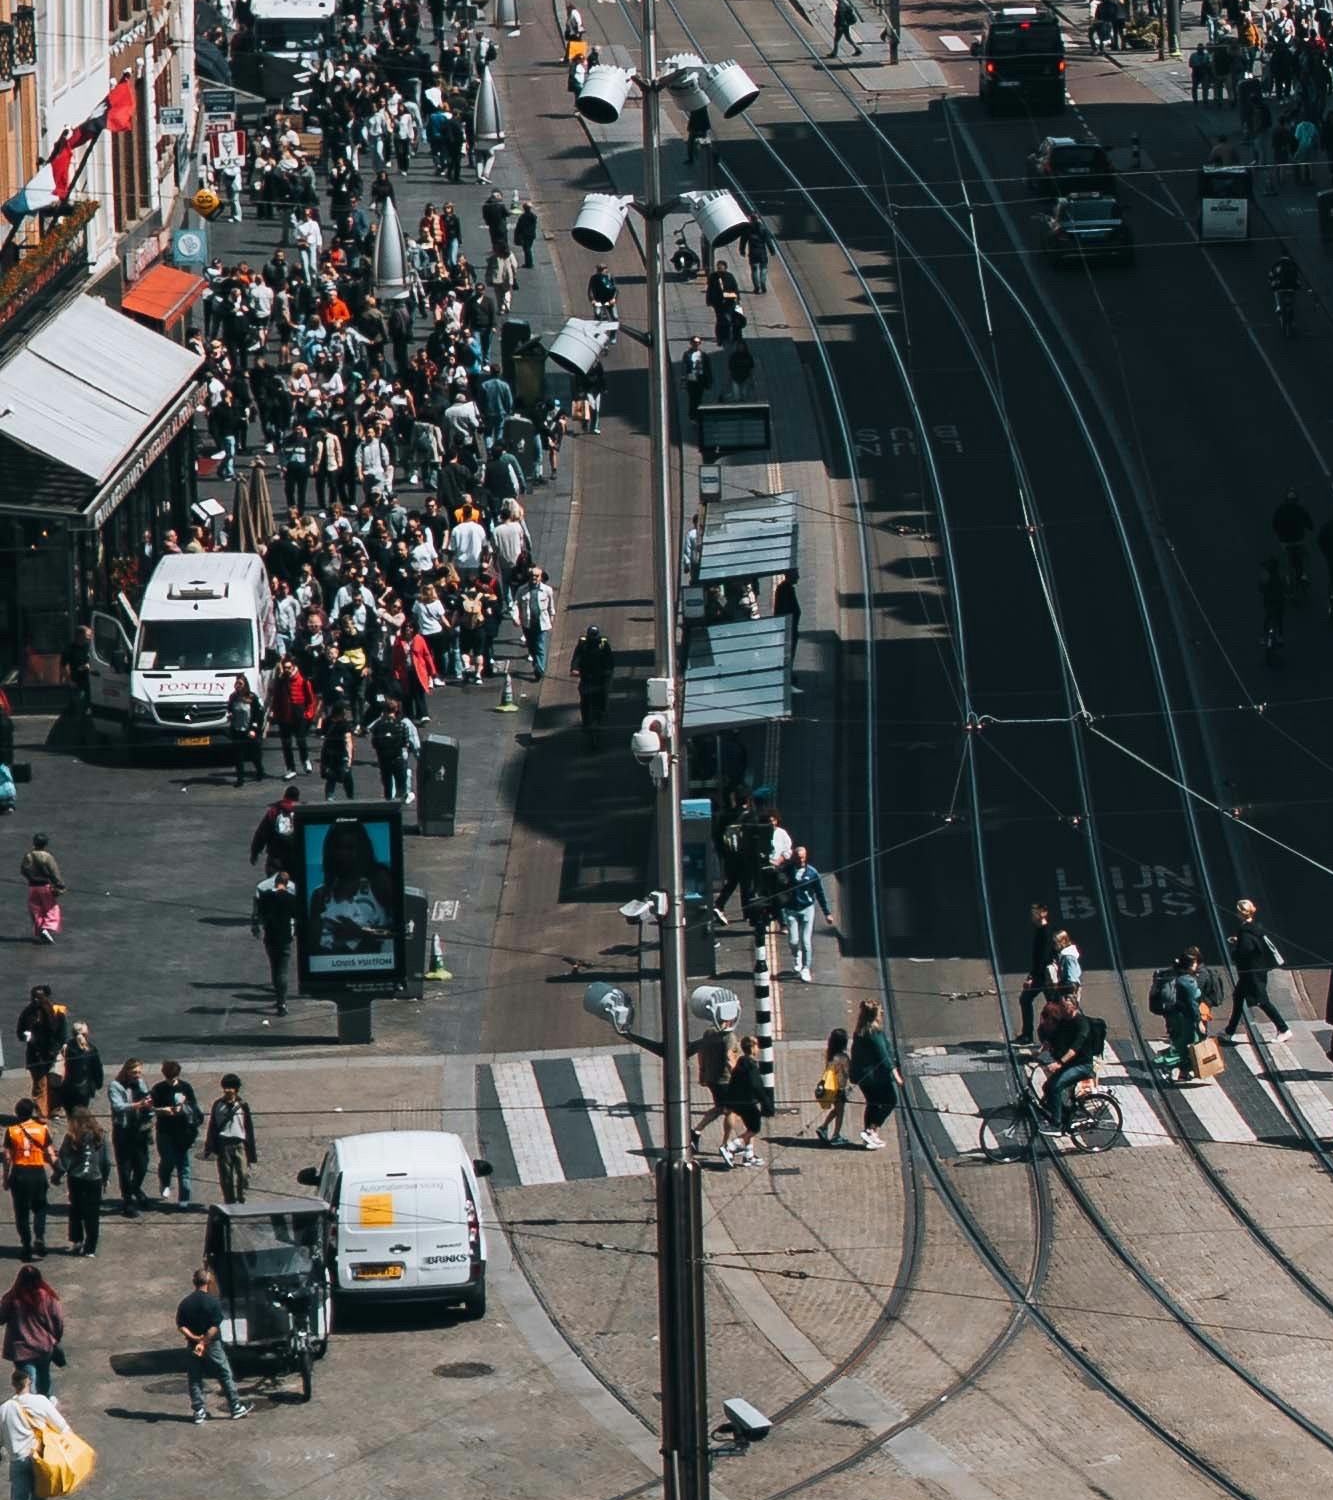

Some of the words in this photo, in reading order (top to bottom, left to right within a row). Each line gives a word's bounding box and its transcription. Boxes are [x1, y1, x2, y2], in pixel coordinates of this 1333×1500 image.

[160, 682, 225, 694] FONTIJN
[1056, 863, 1196, 891] LIJN
[1059, 891, 1197, 920] BUS
